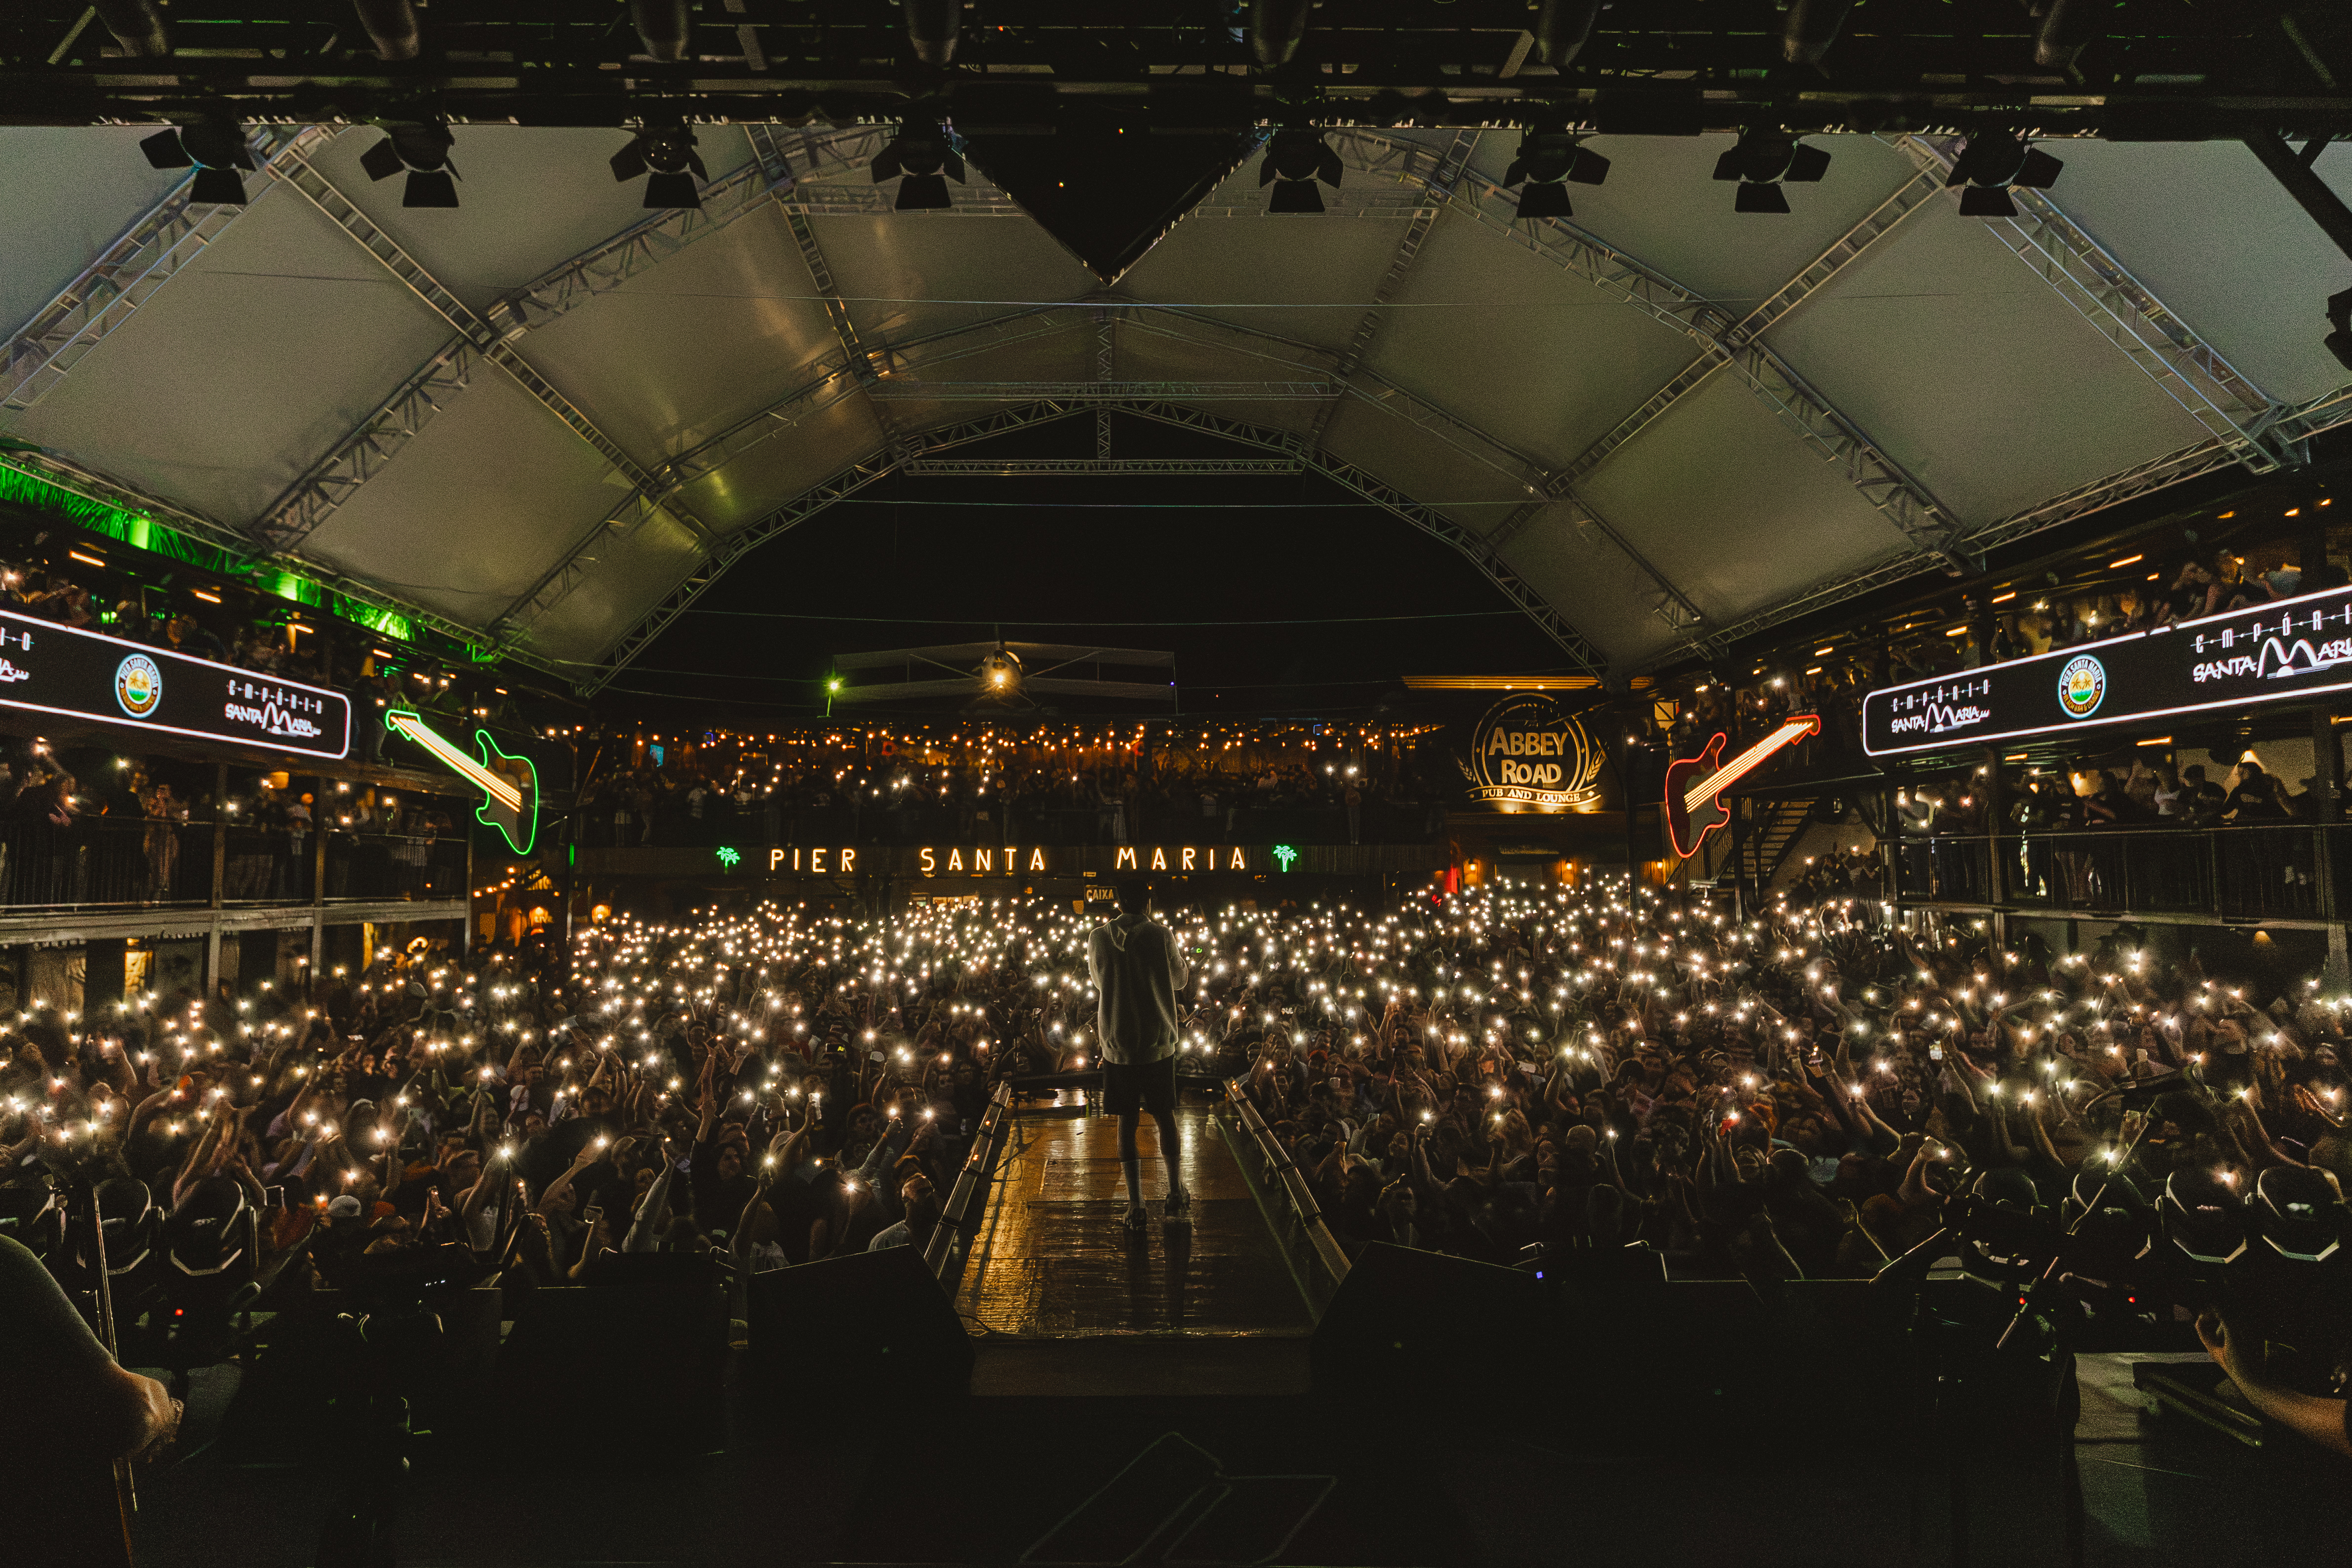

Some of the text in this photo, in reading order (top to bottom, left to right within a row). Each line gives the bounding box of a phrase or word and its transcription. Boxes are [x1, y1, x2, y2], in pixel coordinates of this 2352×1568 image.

[2196, 603, 2351, 653] EMPÓRI
[2062, 659, 2102, 686] PIER SANTA MARIA
[2193, 637, 2352, 683] SANTA MARI
[225, 701, 313, 733] SANTA MARIA
[1891, 702, 1980, 733] SANTA MARIA
[1488, 727, 1568, 756] ABBEY
[1501, 759, 1561, 784] ROAD
[1482, 788, 1581, 803] PUB AND LOUNGE
[770, 847, 1245, 873] PIER SANTA MARIA
[1086, 889, 1114, 900] CAIXA
